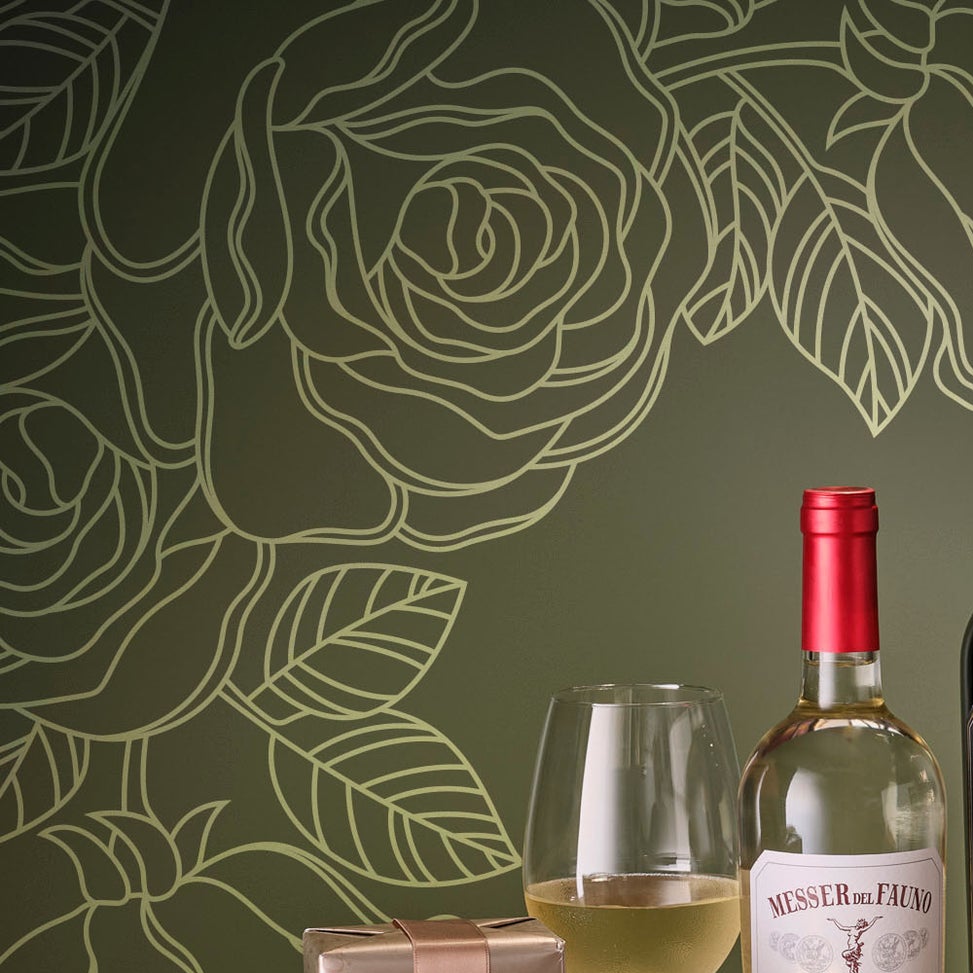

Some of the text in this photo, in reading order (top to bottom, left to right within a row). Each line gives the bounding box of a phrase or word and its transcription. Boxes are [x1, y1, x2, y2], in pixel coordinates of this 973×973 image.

[767, 882, 932, 919] MESSER DEL FAUNO
